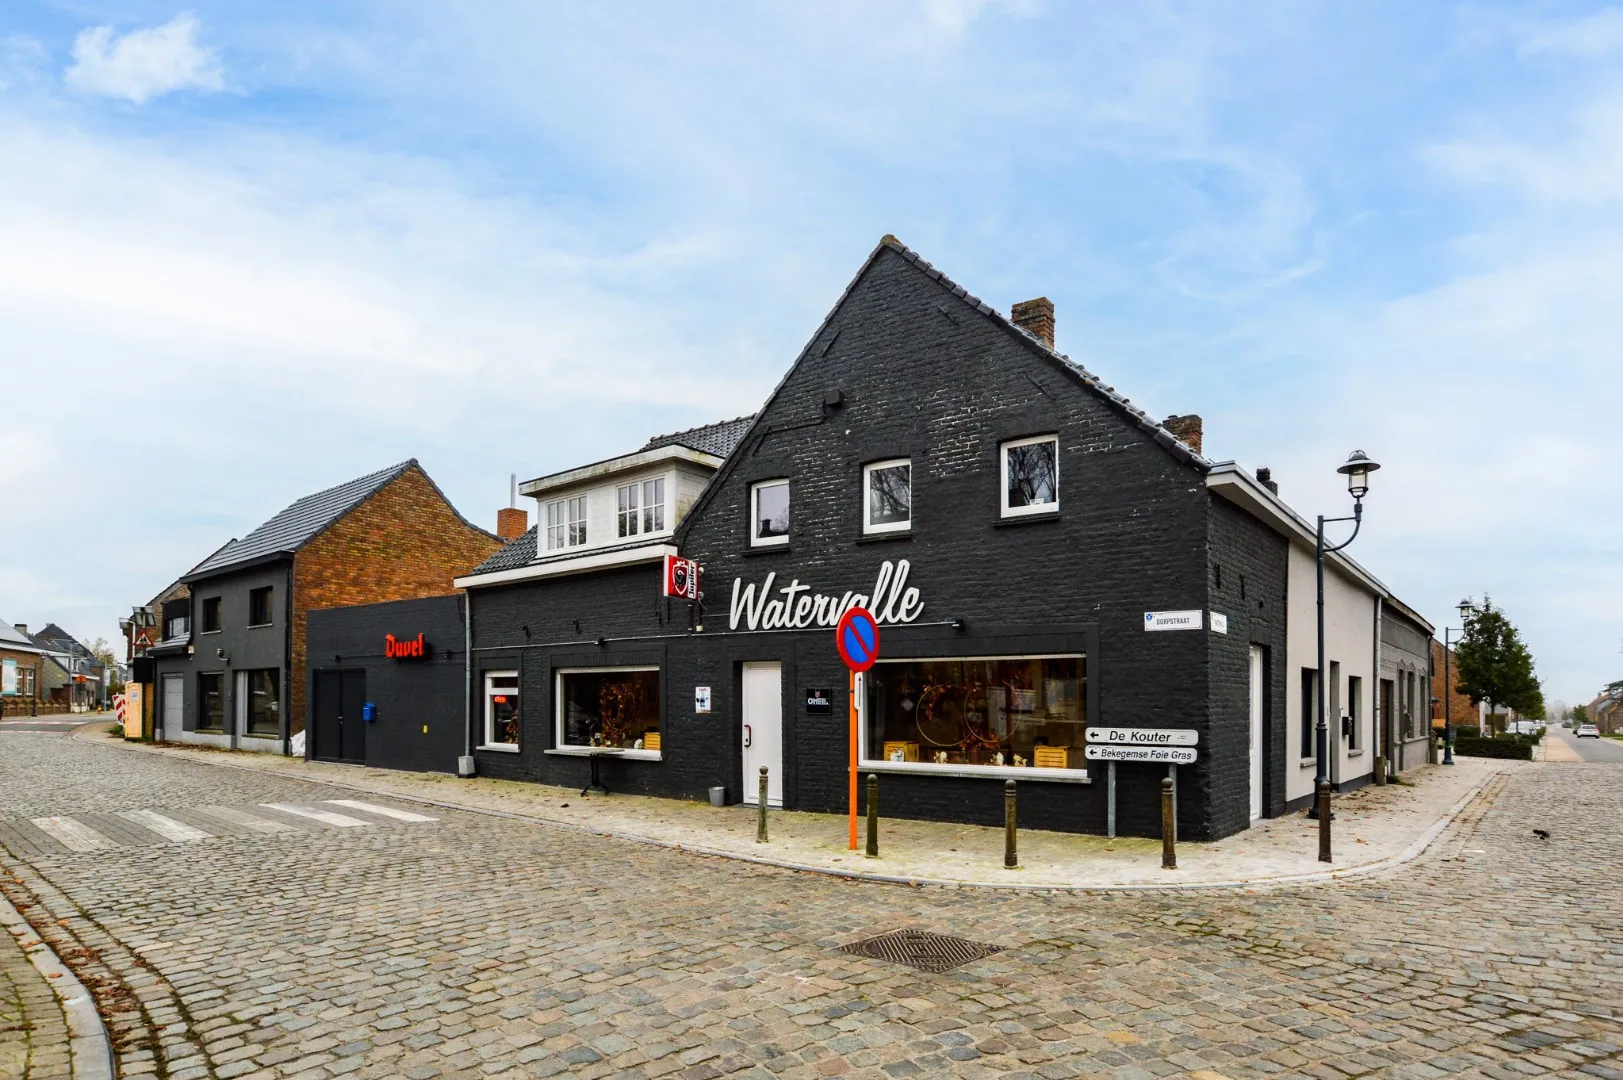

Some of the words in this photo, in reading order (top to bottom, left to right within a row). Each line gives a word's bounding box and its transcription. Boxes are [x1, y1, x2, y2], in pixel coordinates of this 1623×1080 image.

[1156, 617, 1190, 625] DORPSTRAAT
[385, 633, 423, 658] Duvel
[1109, 731, 1125, 741] De
[1130, 731, 1171, 742] Kouter
[1101, 749, 1148, 760] Bekegemse
[1150, 750, 1169, 759] Foie
[1171, 751, 1192, 760] Gras
